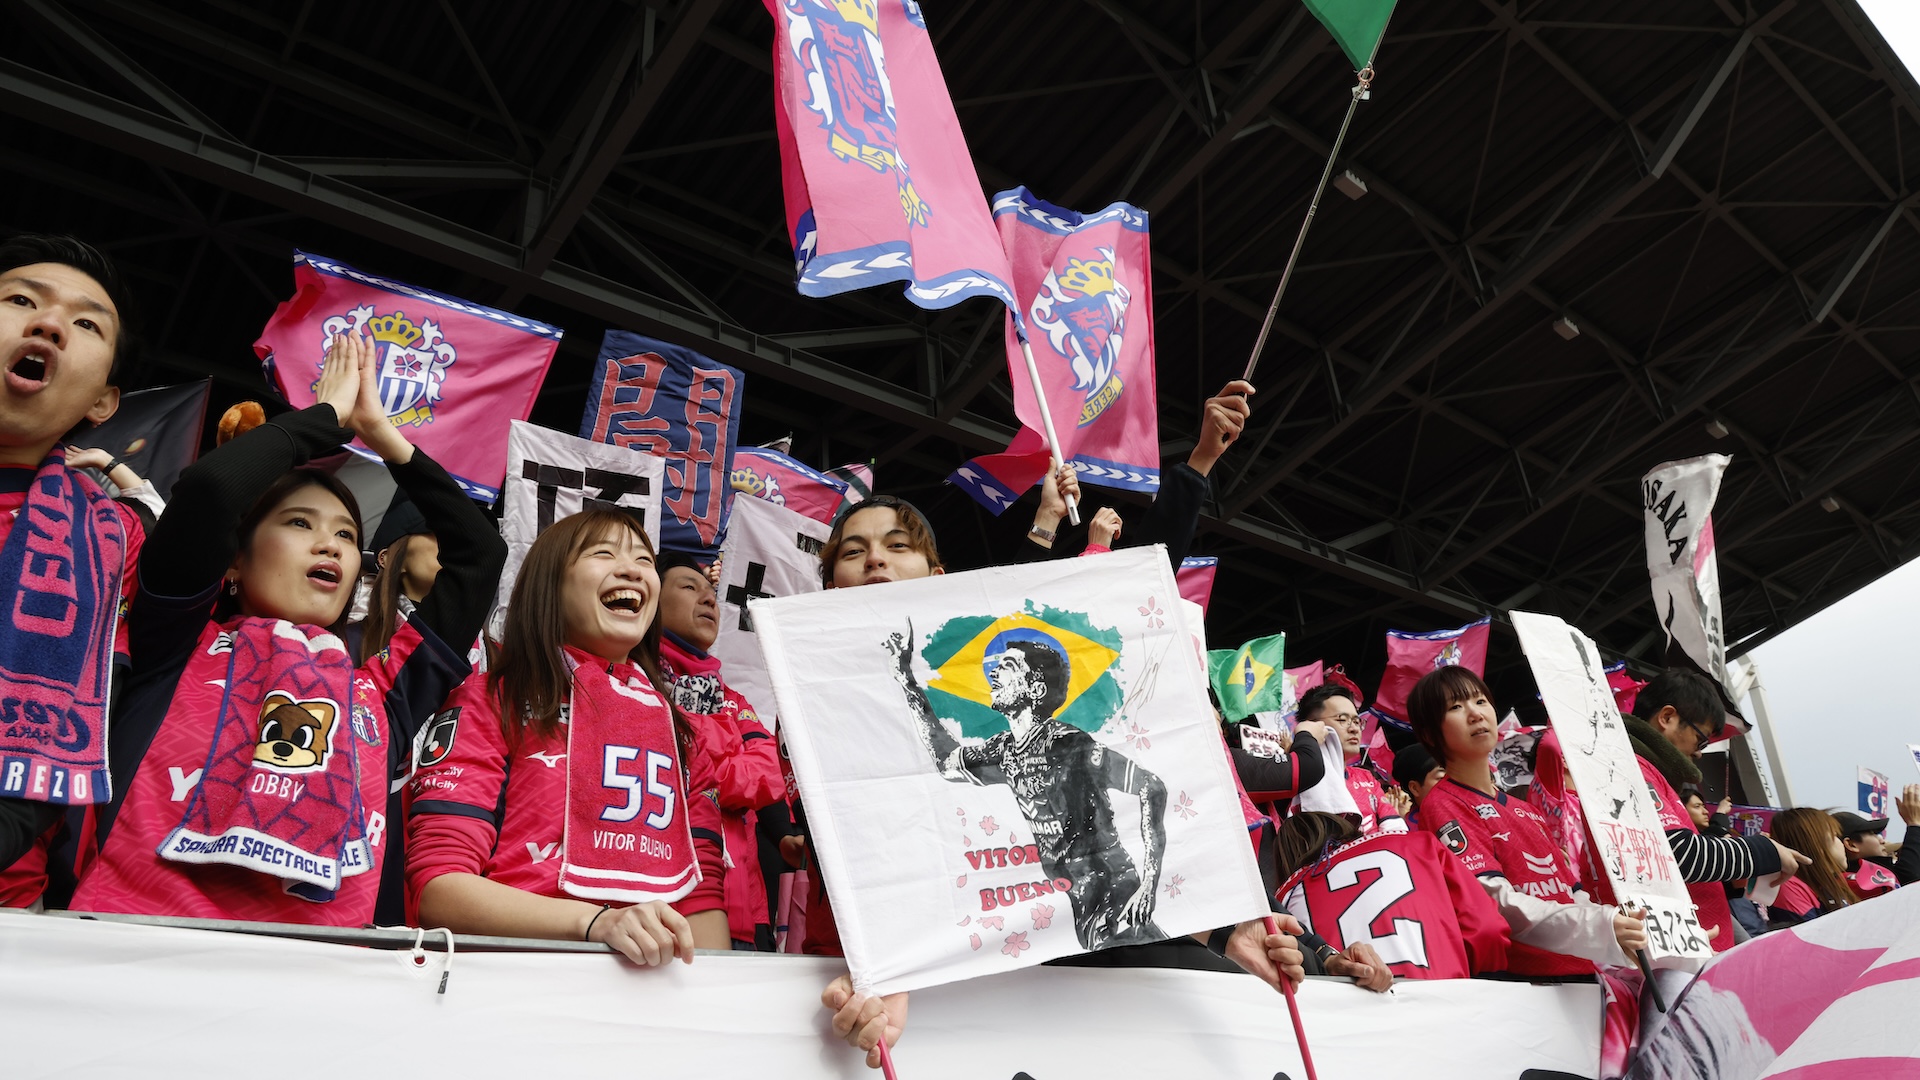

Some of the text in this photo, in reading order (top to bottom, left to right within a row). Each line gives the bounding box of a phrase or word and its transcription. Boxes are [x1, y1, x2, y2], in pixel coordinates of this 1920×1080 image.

[600, 744, 676, 831] 55
[239, 837, 332, 879] SPECTACLE
[593, 829, 672, 861] VITOR BUENO
[964, 843, 1042, 870] VITOR
[979, 876, 1073, 912] BUENO
